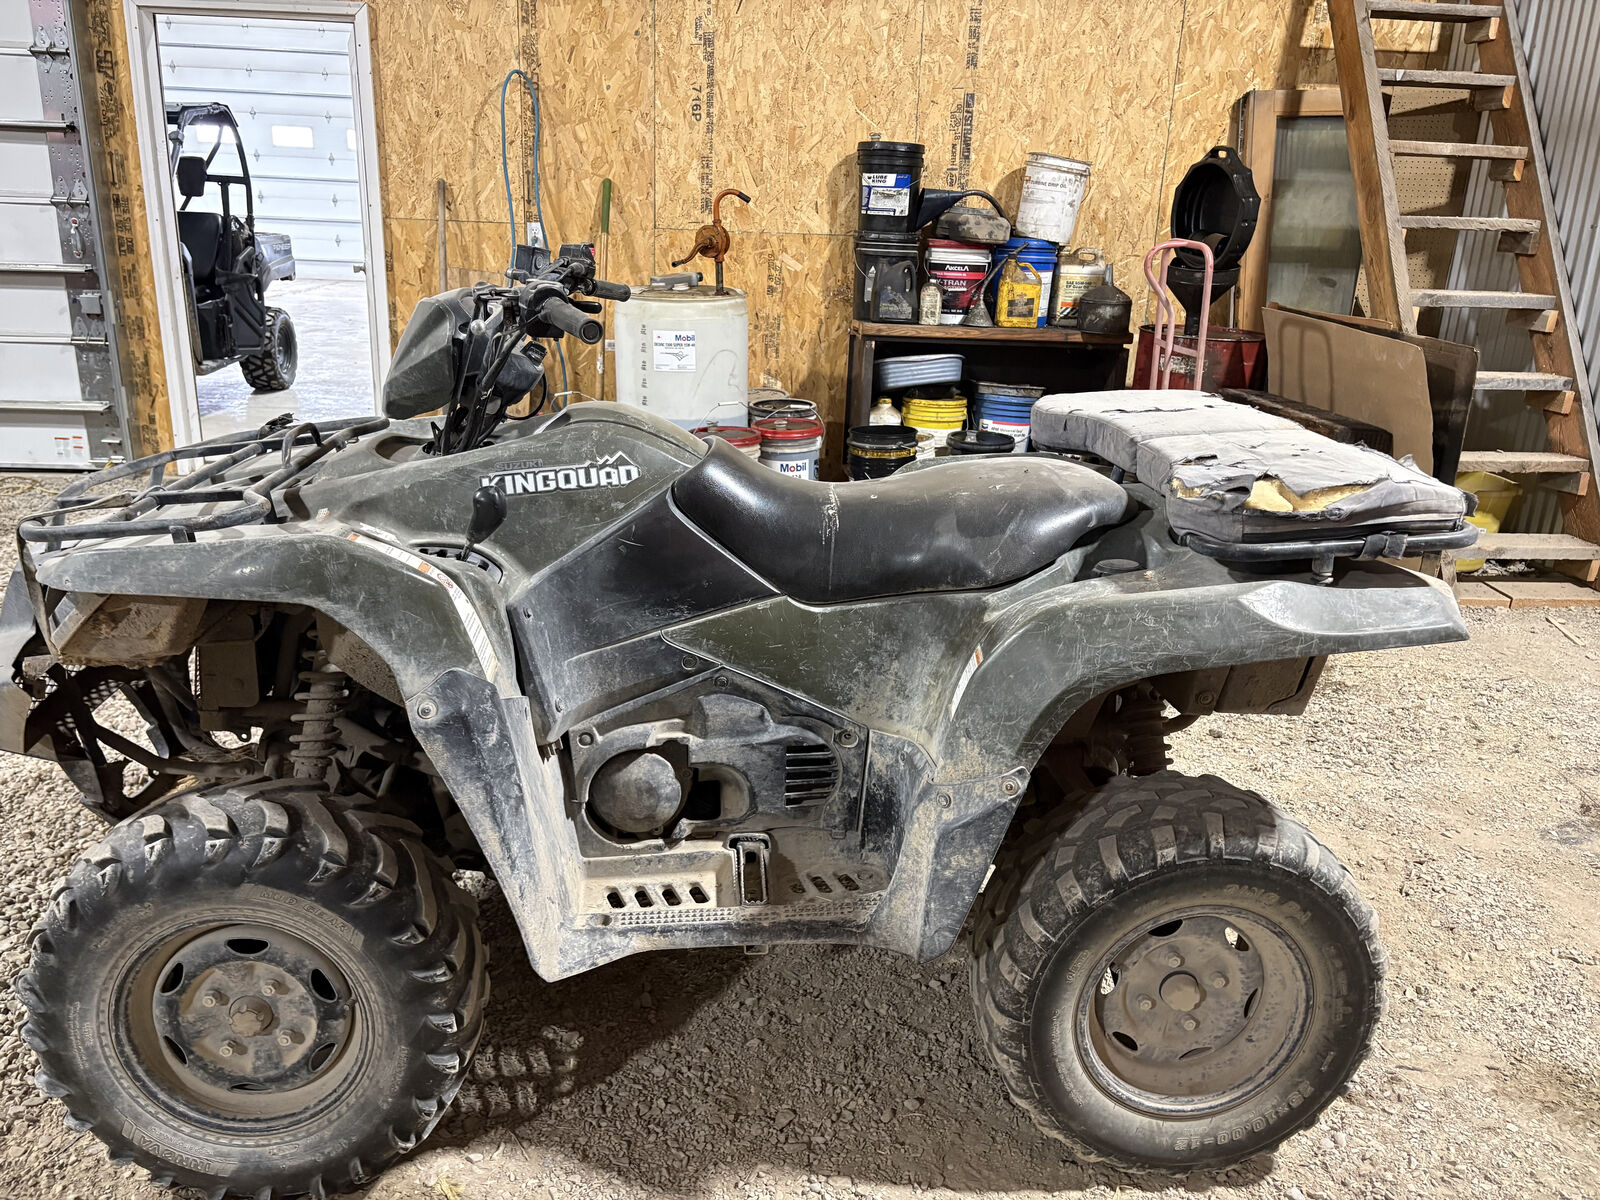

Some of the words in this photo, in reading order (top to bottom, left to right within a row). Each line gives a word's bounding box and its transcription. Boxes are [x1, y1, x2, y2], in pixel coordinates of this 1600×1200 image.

[691, 85, 702, 122] 716P
[950, 143, 958, 166] NORTH
[675, 334, 696, 342] Mobil
[494, 459, 544, 471] SUZUKI
[780, 462, 807, 473] Mobil
[480, 465, 641, 497] KINGQUAD
[259, 889, 302, 909] MUD
[303, 901, 354, 936] GEAR
[133, 1130, 213, 1176] INNOVA
